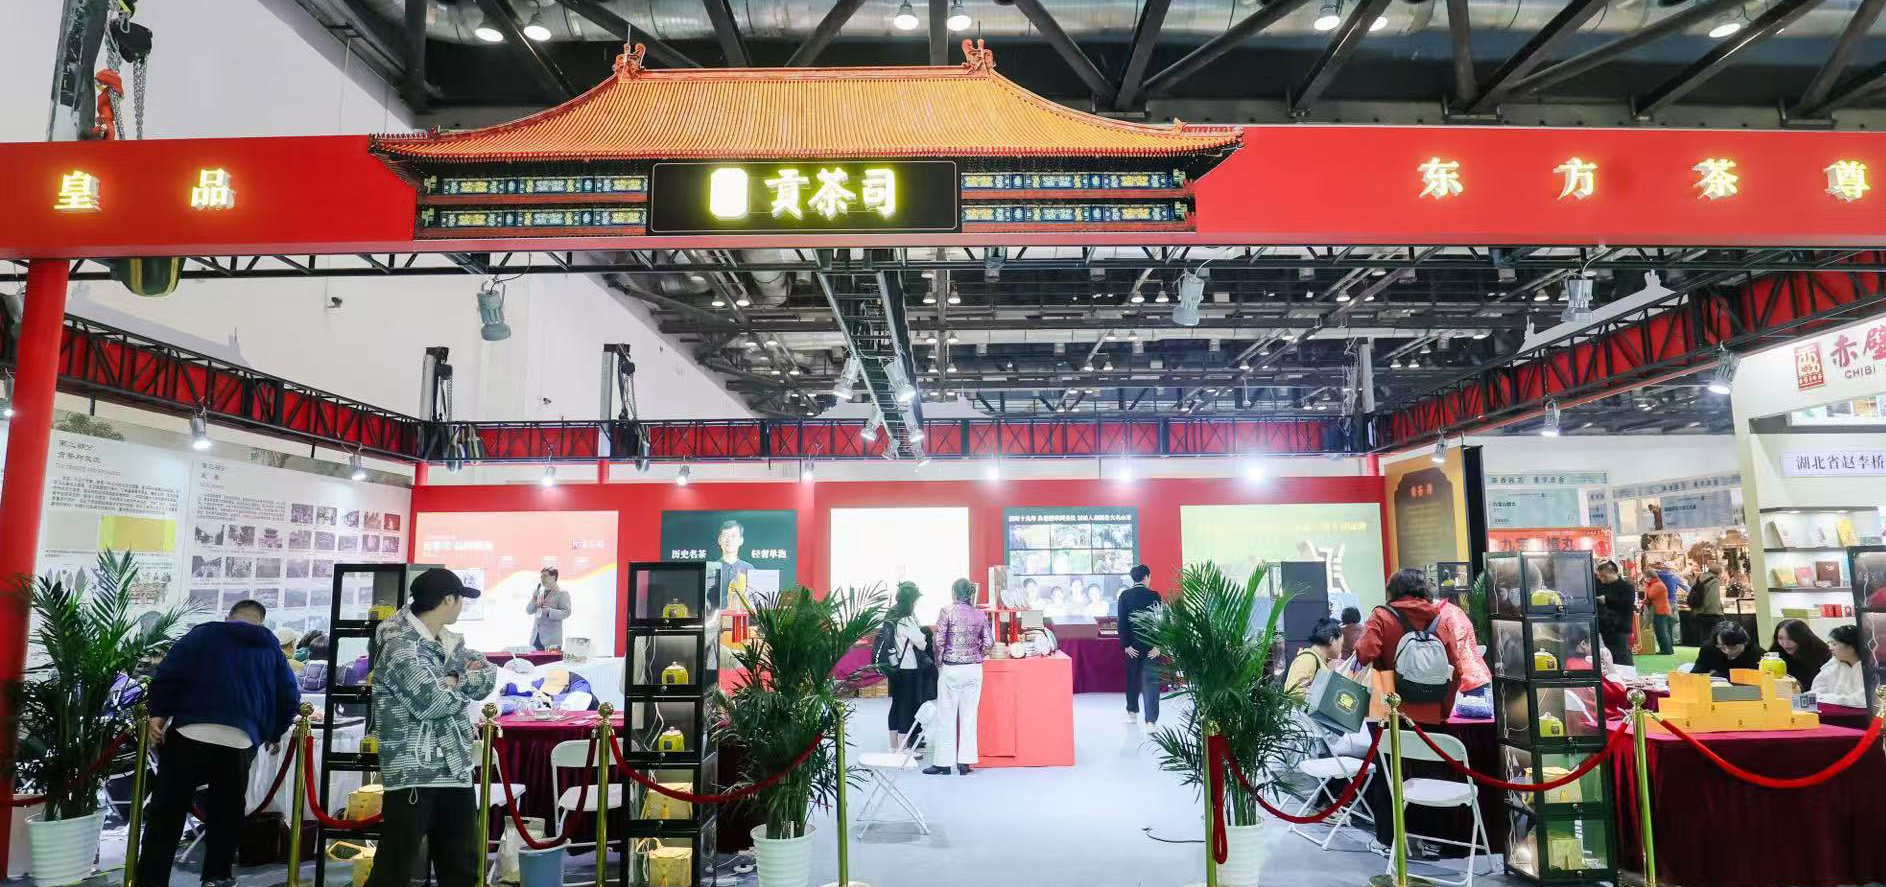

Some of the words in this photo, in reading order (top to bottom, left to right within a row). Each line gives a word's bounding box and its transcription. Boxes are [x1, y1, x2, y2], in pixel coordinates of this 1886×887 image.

[764, 167, 897, 220] 贡茶司
[1844, 365, 1876, 379] CHIBI
[671, 549, 707, 560] 历史名茶
